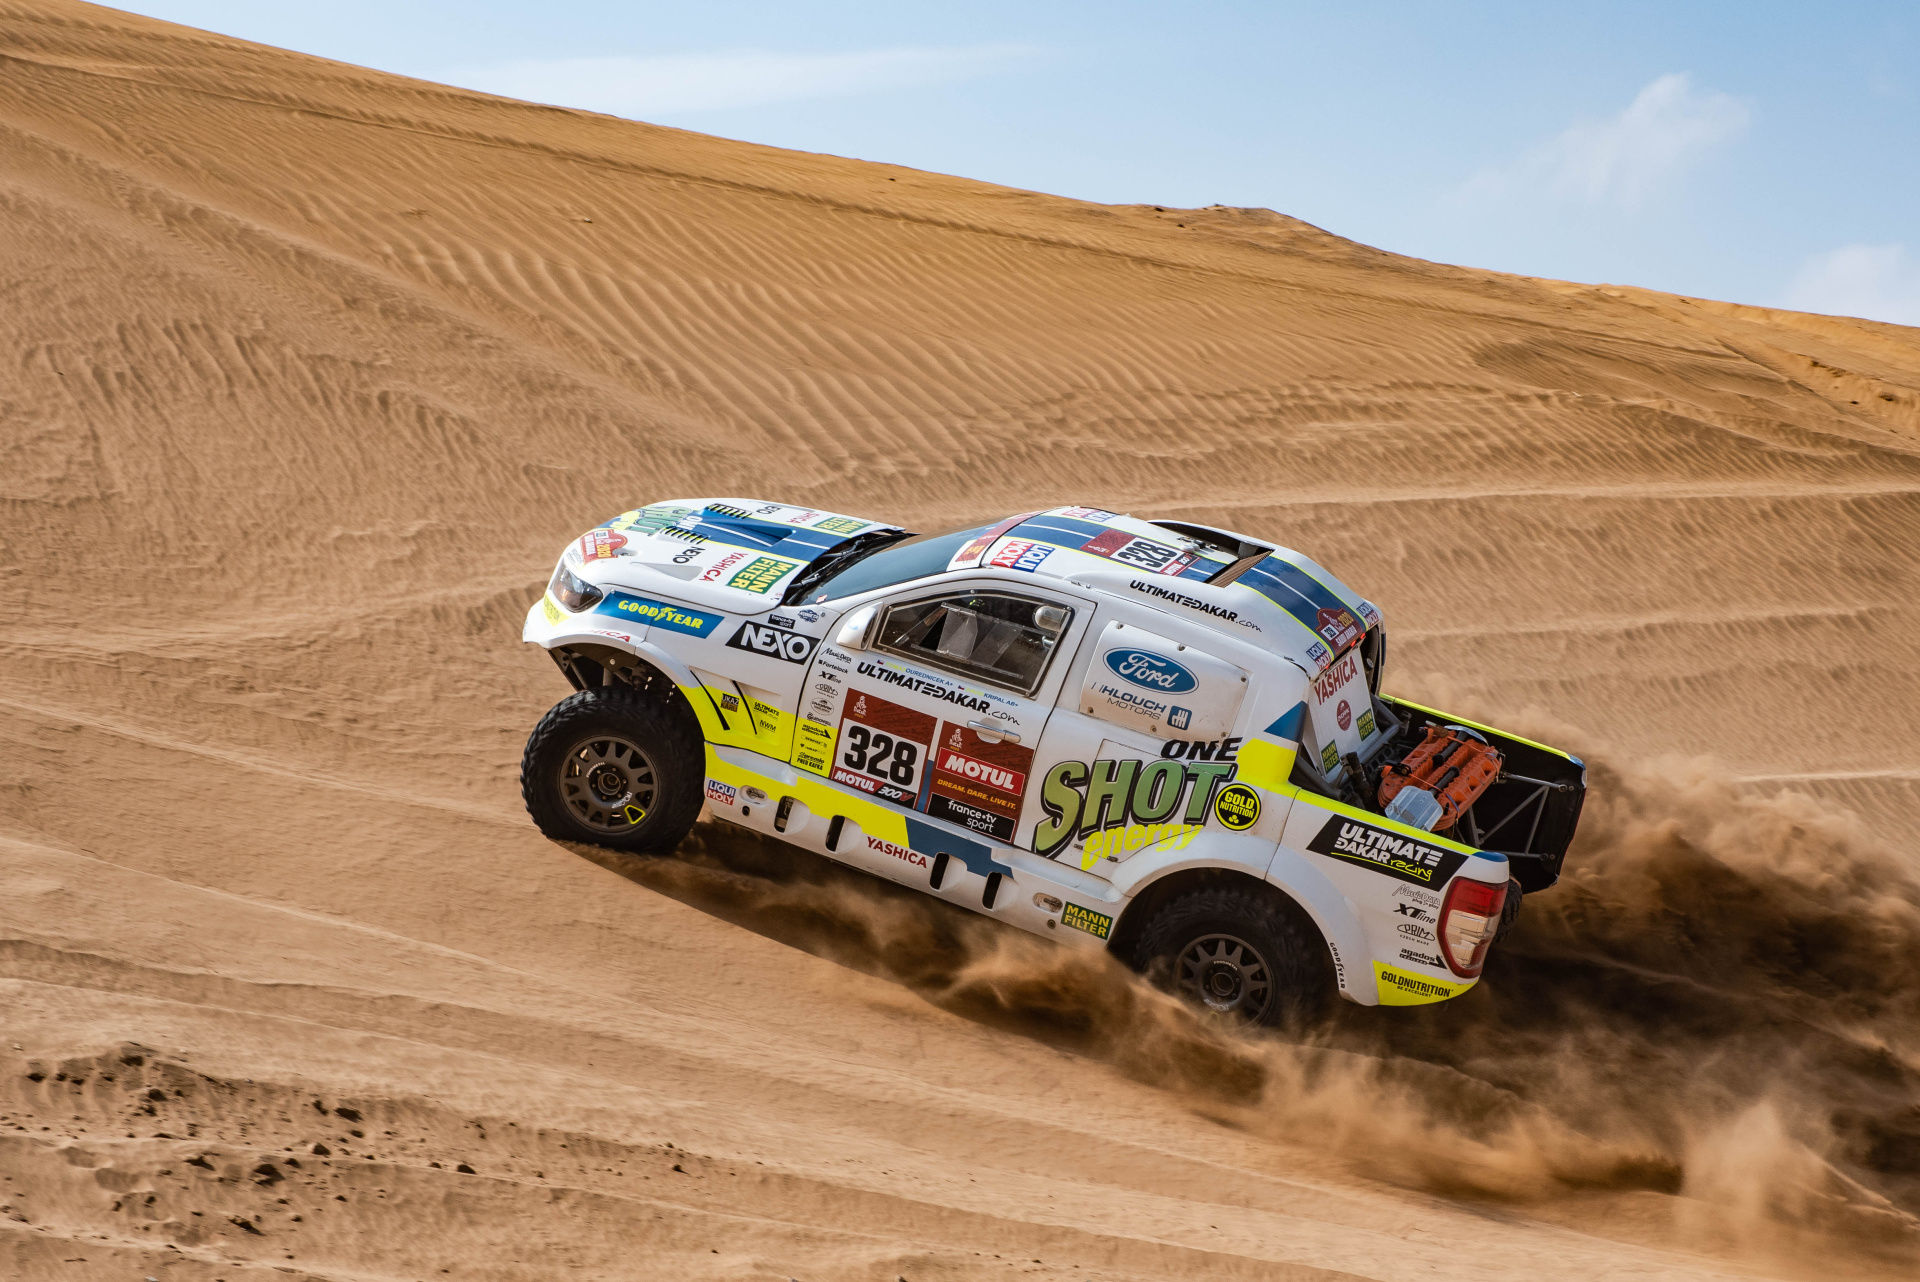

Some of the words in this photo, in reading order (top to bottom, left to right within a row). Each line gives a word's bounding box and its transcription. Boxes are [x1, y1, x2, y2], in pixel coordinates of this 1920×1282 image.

[698, 553, 749, 582] YASHICA
[992, 541, 1032, 568] MOLY
[1014, 544, 1054, 570] LIQUI
[1117, 541, 1177, 568] 328
[731, 558, 776, 588] FILTER
[748, 562, 792, 593] MANN
[618, 599, 704, 629] GOODYEAR
[740, 623, 811, 660] NEXO
[822, 660, 849, 674] Fortelock
[1118, 652, 1180, 689] Ford
[1313, 655, 1358, 706] YASHICA
[1102, 685, 1167, 713] HLOUCH
[1106, 697, 1162, 721] MOTORS
[844, 725, 918, 787] 328
[1160, 737, 1243, 762] ONE
[1322, 742, 1338, 763] MANN
[1324, 753, 1340, 774] FILTER
[834, 770, 876, 792] MOTUL
[877, 786, 914, 803] 300V
[944, 755, 1015, 790] MOTUL
[707, 790, 735, 806] MOLY
[708, 780, 736, 797] LIQUI
[937, 778, 966, 794] DREAM.
[967, 789, 989, 801] DARE.
[990, 796, 1007, 807] LIVE
[1224, 791, 1256, 810] GOLD
[1031, 759, 1239, 861] SHOT
[1219, 801, 1256, 819] NUTRITION
[966, 818, 994, 833] sport
[867, 836, 928, 869] YASHICA
[1081, 823, 1205, 872] energy
[1339, 822, 1444, 868] ULTIMATE
[1334, 838, 1391, 864] DAKAR
[1389, 858, 1433, 882] racing
[1063, 914, 1107, 938] FILTER
[1065, 903, 1109, 928] MANN
[1329, 941, 1346, 990] GOODYEAR
[1401, 948, 1436, 962] agados
[1381, 970, 1451, 998] GOLDNUTRITION
